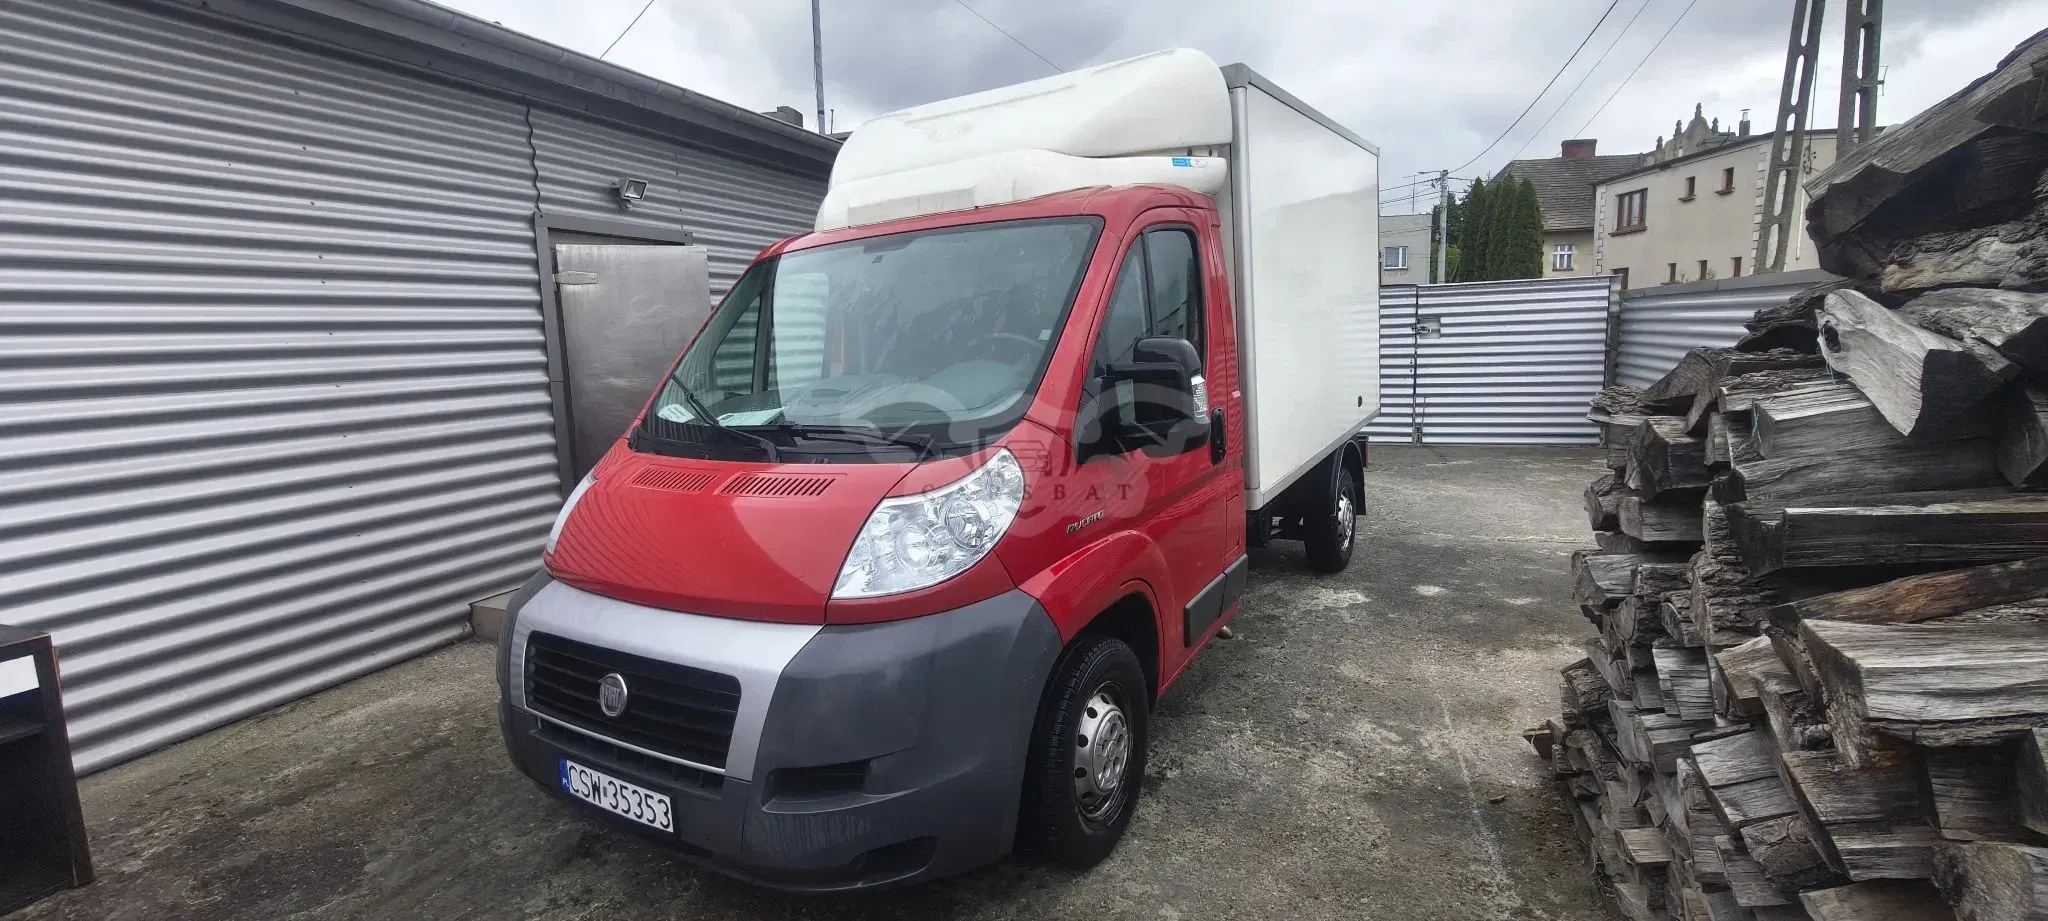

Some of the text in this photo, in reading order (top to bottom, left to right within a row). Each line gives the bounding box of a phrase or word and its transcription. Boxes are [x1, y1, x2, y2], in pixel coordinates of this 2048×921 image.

[604, 684, 621, 708] FIAT
[568, 764, 671, 830] CSW 35353
